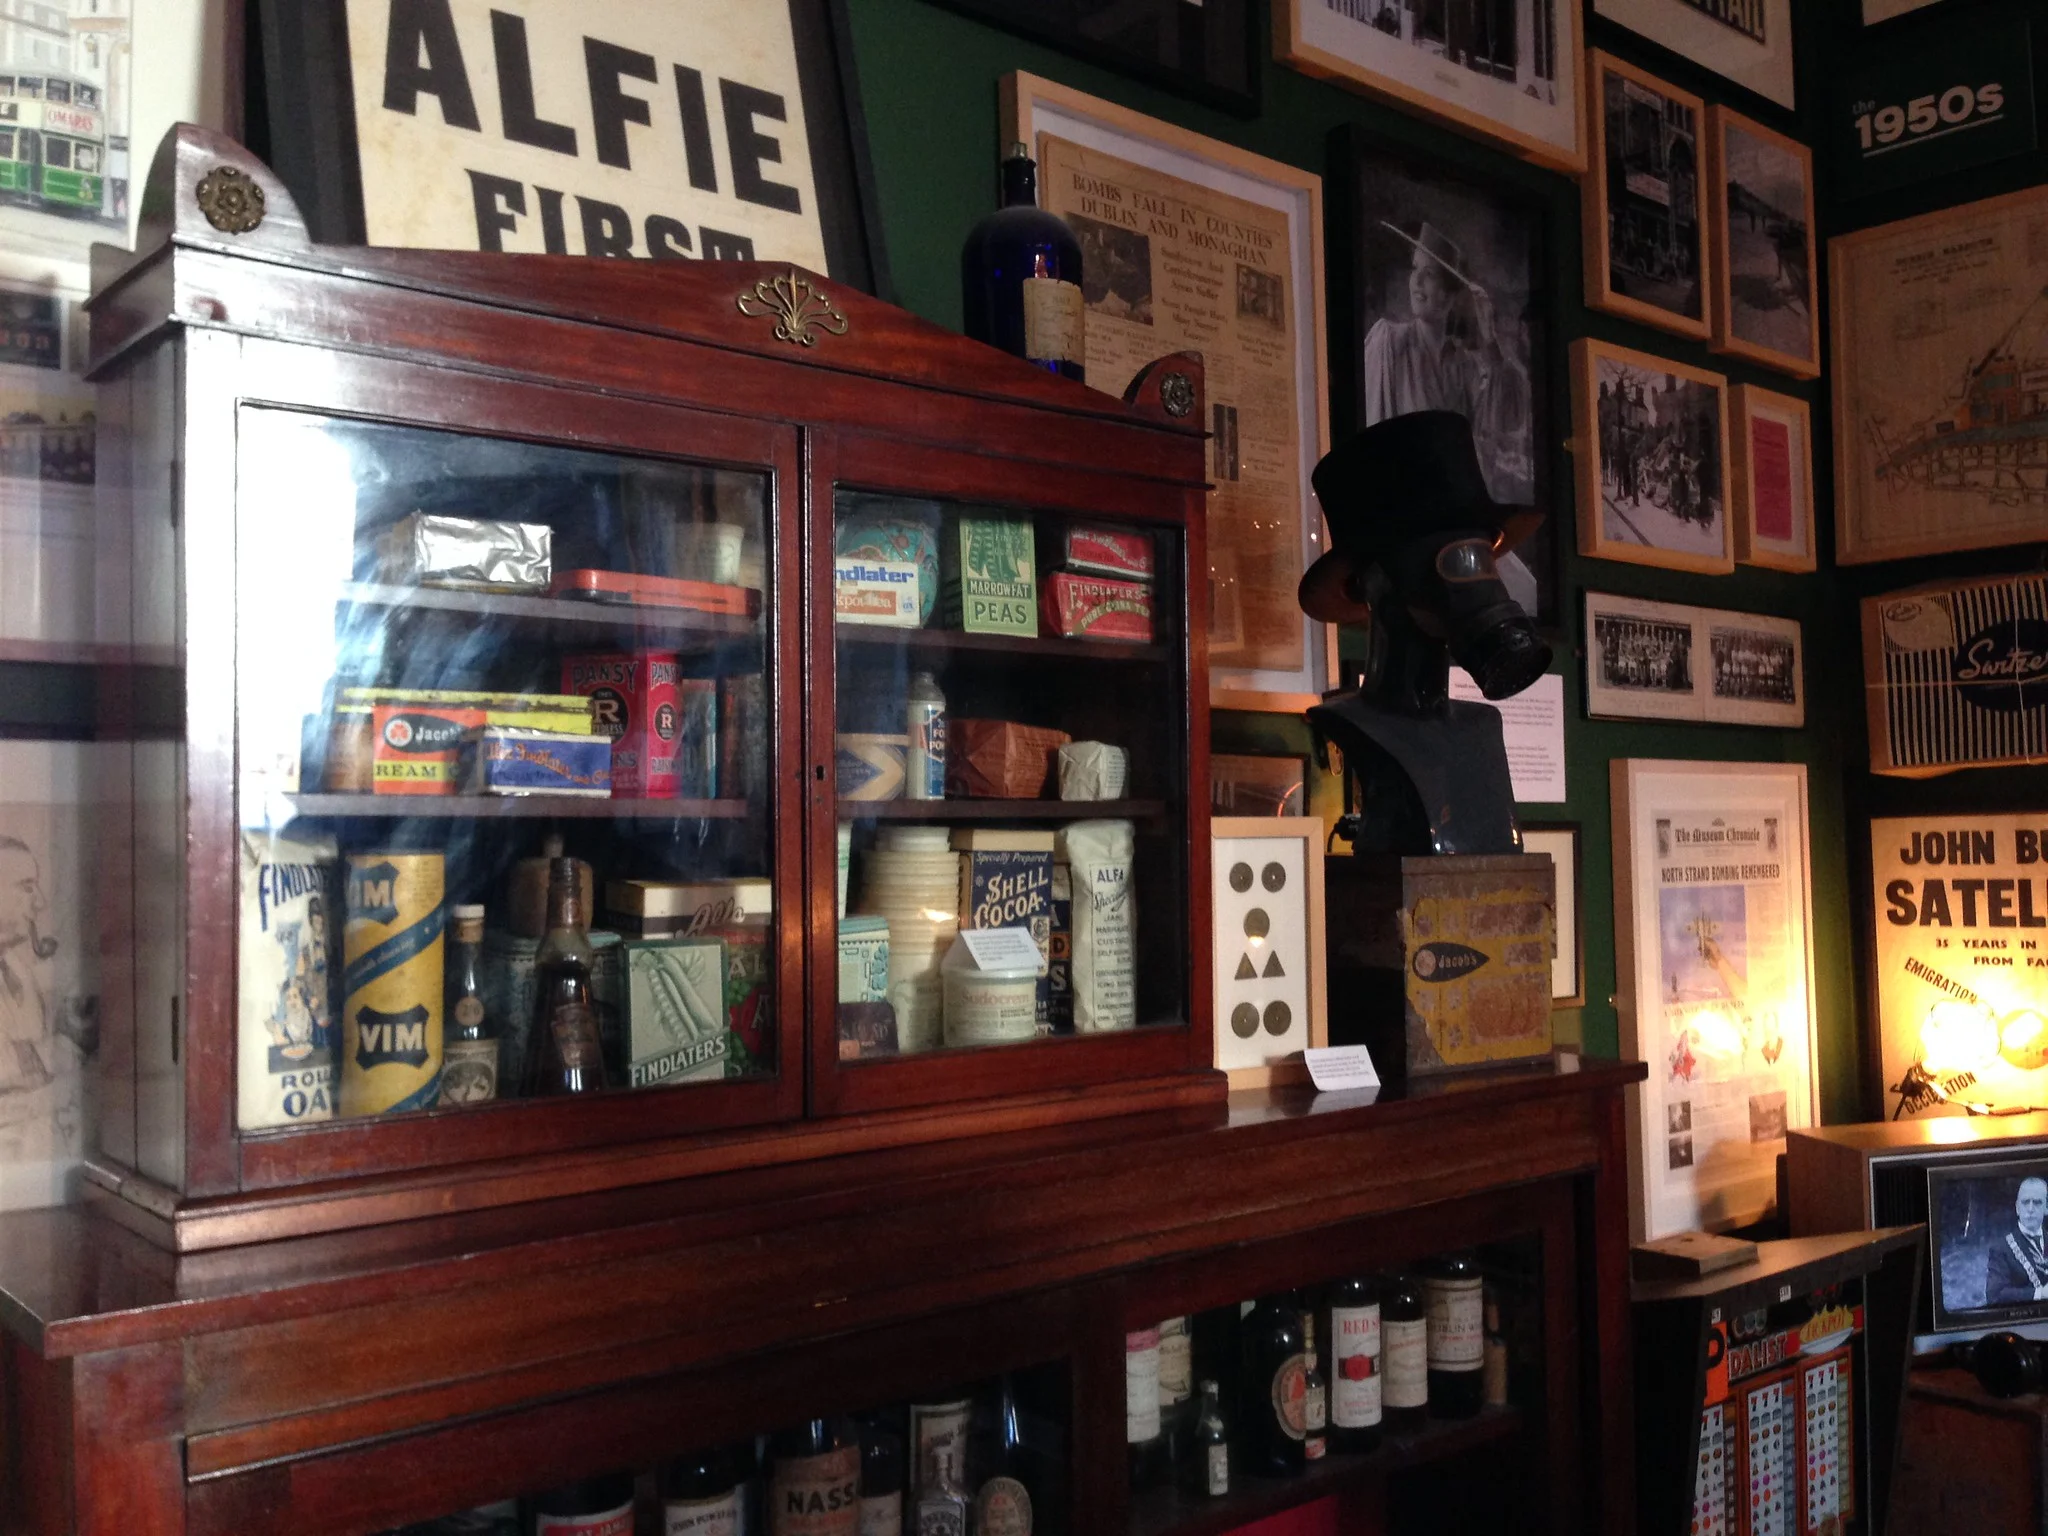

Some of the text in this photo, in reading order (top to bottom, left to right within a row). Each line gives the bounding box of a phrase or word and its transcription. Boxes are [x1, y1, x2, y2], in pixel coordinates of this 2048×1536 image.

[383, 0, 802, 215] ALFIE
[1852, 97, 1876, 115] the
[1855, 82, 2005, 150] 1950s
[1073, 174, 1273, 249] BOMBS FALL IN COUNTIES
[1081, 197, 1267, 266] DUBLIN AND MONAGHAN
[836, 565, 914, 583] ndlater
[970, 580, 1029, 598] MARROWFAT
[974, 601, 1027, 624] PEAS
[572, 660, 639, 696] PANSY
[594, 699, 620, 723] R
[661, 713, 673, 728] R
[1675, 827, 1760, 843] The Museum Chronicle
[1900, 830, 1996, 865] JOHN
[975, 851, 1048, 865] Specially Prepared
[985, 866, 1049, 905] SHELL
[1661, 864, 1780, 882] NORTH STRAND BOMBING REMEMBERED
[1885, 878, 2048, 928] SATEL
[1962, 939, 2007, 949] YEARS
[2020, 939, 2037, 950] IN
[1438, 953, 1478, 969] Jacob's
[1973, 956, 2013, 966] FROM
[1904, 957, 1978, 1004] EMIGRATION
[360, 1022, 423, 1053] VIM
[630, 1036, 726, 1089] FINDLATER'S
[1905, 1071, 1977, 1115] OCCUTION
